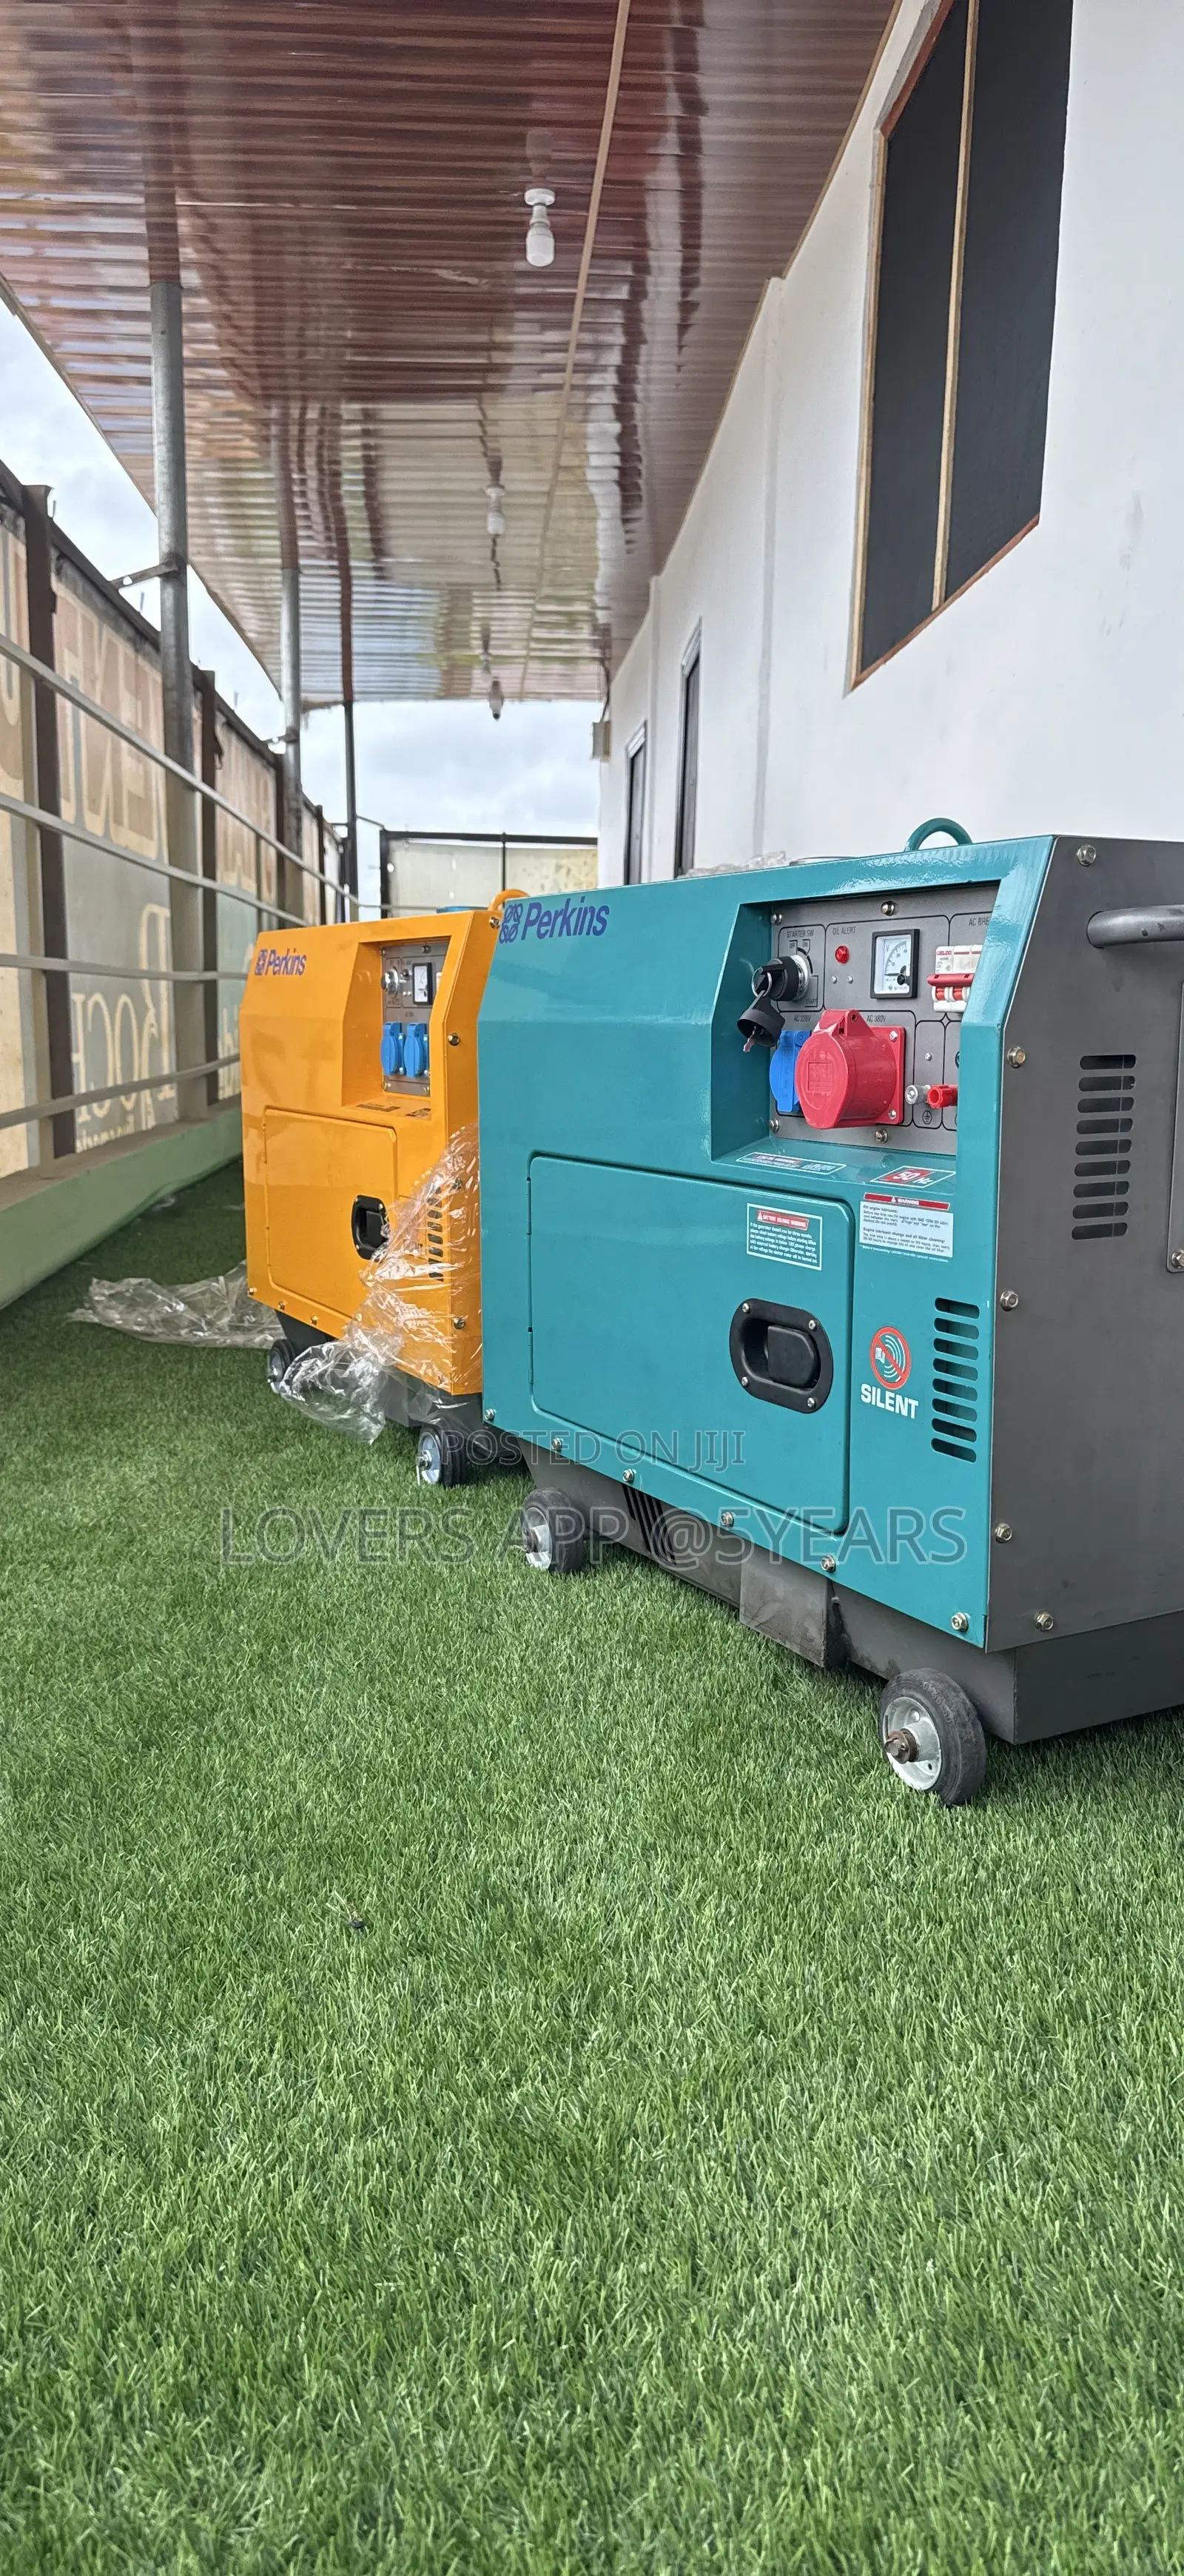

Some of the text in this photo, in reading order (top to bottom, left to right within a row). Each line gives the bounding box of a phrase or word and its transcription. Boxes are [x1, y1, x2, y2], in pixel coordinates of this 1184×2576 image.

[521, 896, 610, 940] Perkins
[787, 930, 805, 938] STARTER
[841, 927, 855, 935] ALERT
[265, 948, 306, 975] Perkins
[892, 1171, 921, 1180] 50
[861, 1383, 918, 1419] SILENT
